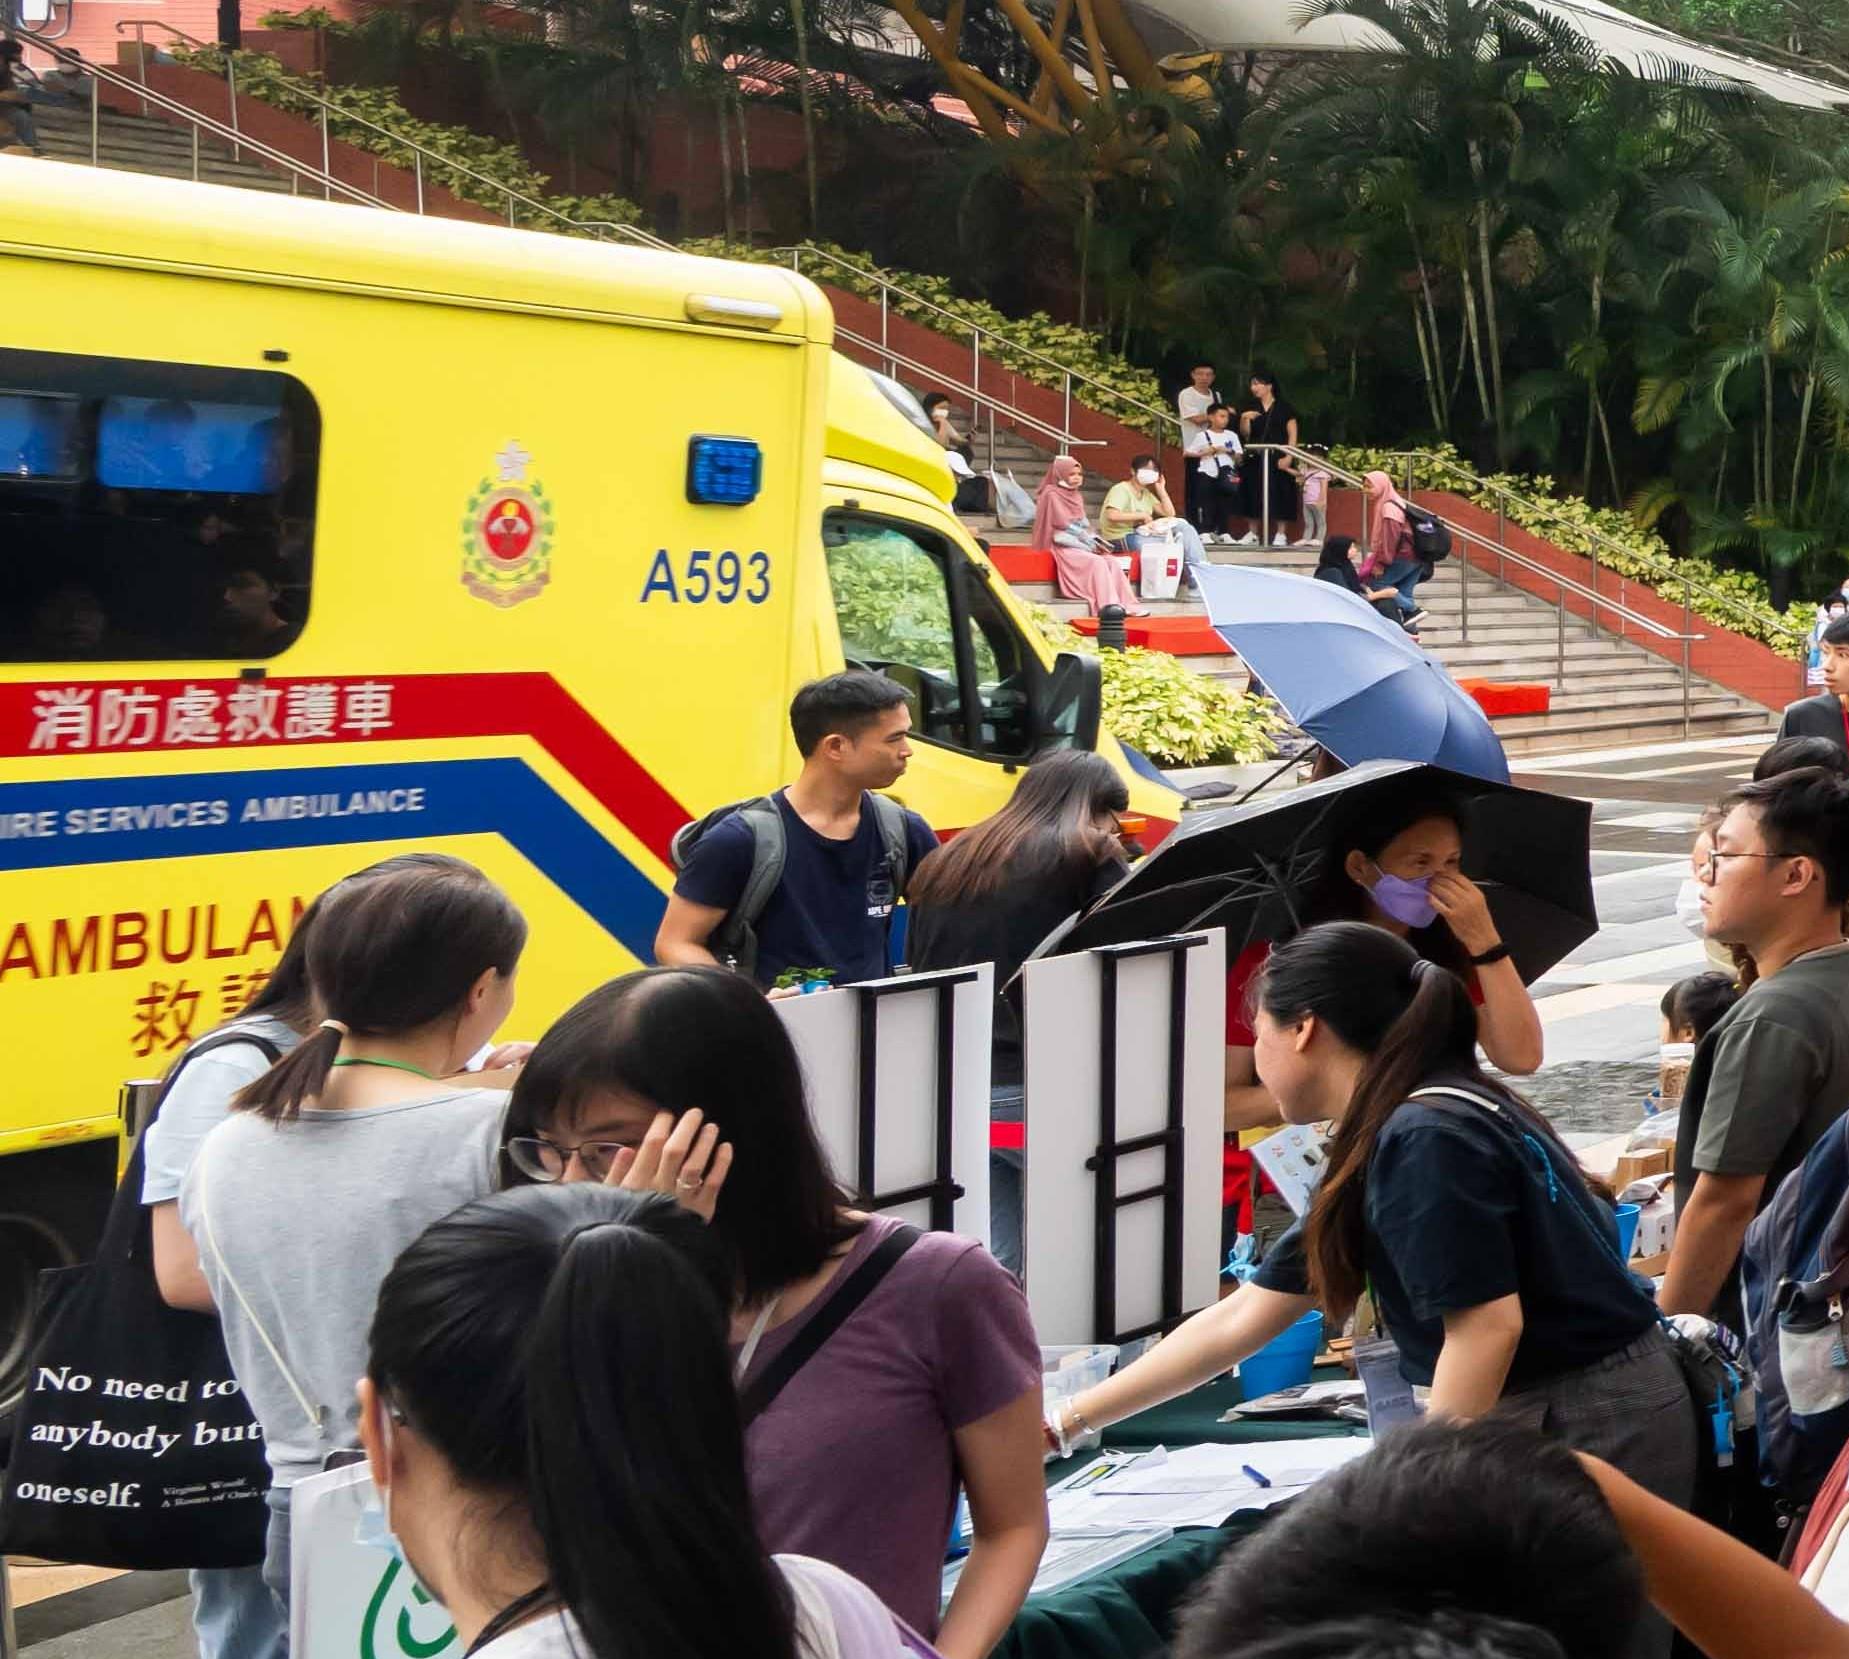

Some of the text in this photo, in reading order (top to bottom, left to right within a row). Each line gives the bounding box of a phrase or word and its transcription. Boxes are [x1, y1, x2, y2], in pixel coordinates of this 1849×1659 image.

[640, 549, 771, 604] A593
[28, 681, 396, 751] 消防處救護車
[0, 788, 426, 839] IRE SERVICES AMBULANCE
[0, 896, 306, 983] AMBULA
[35, 1366, 242, 1403] No need to
[30, 1420, 266, 1458] anybody but
[16, 1482, 142, 1508] oneself.
